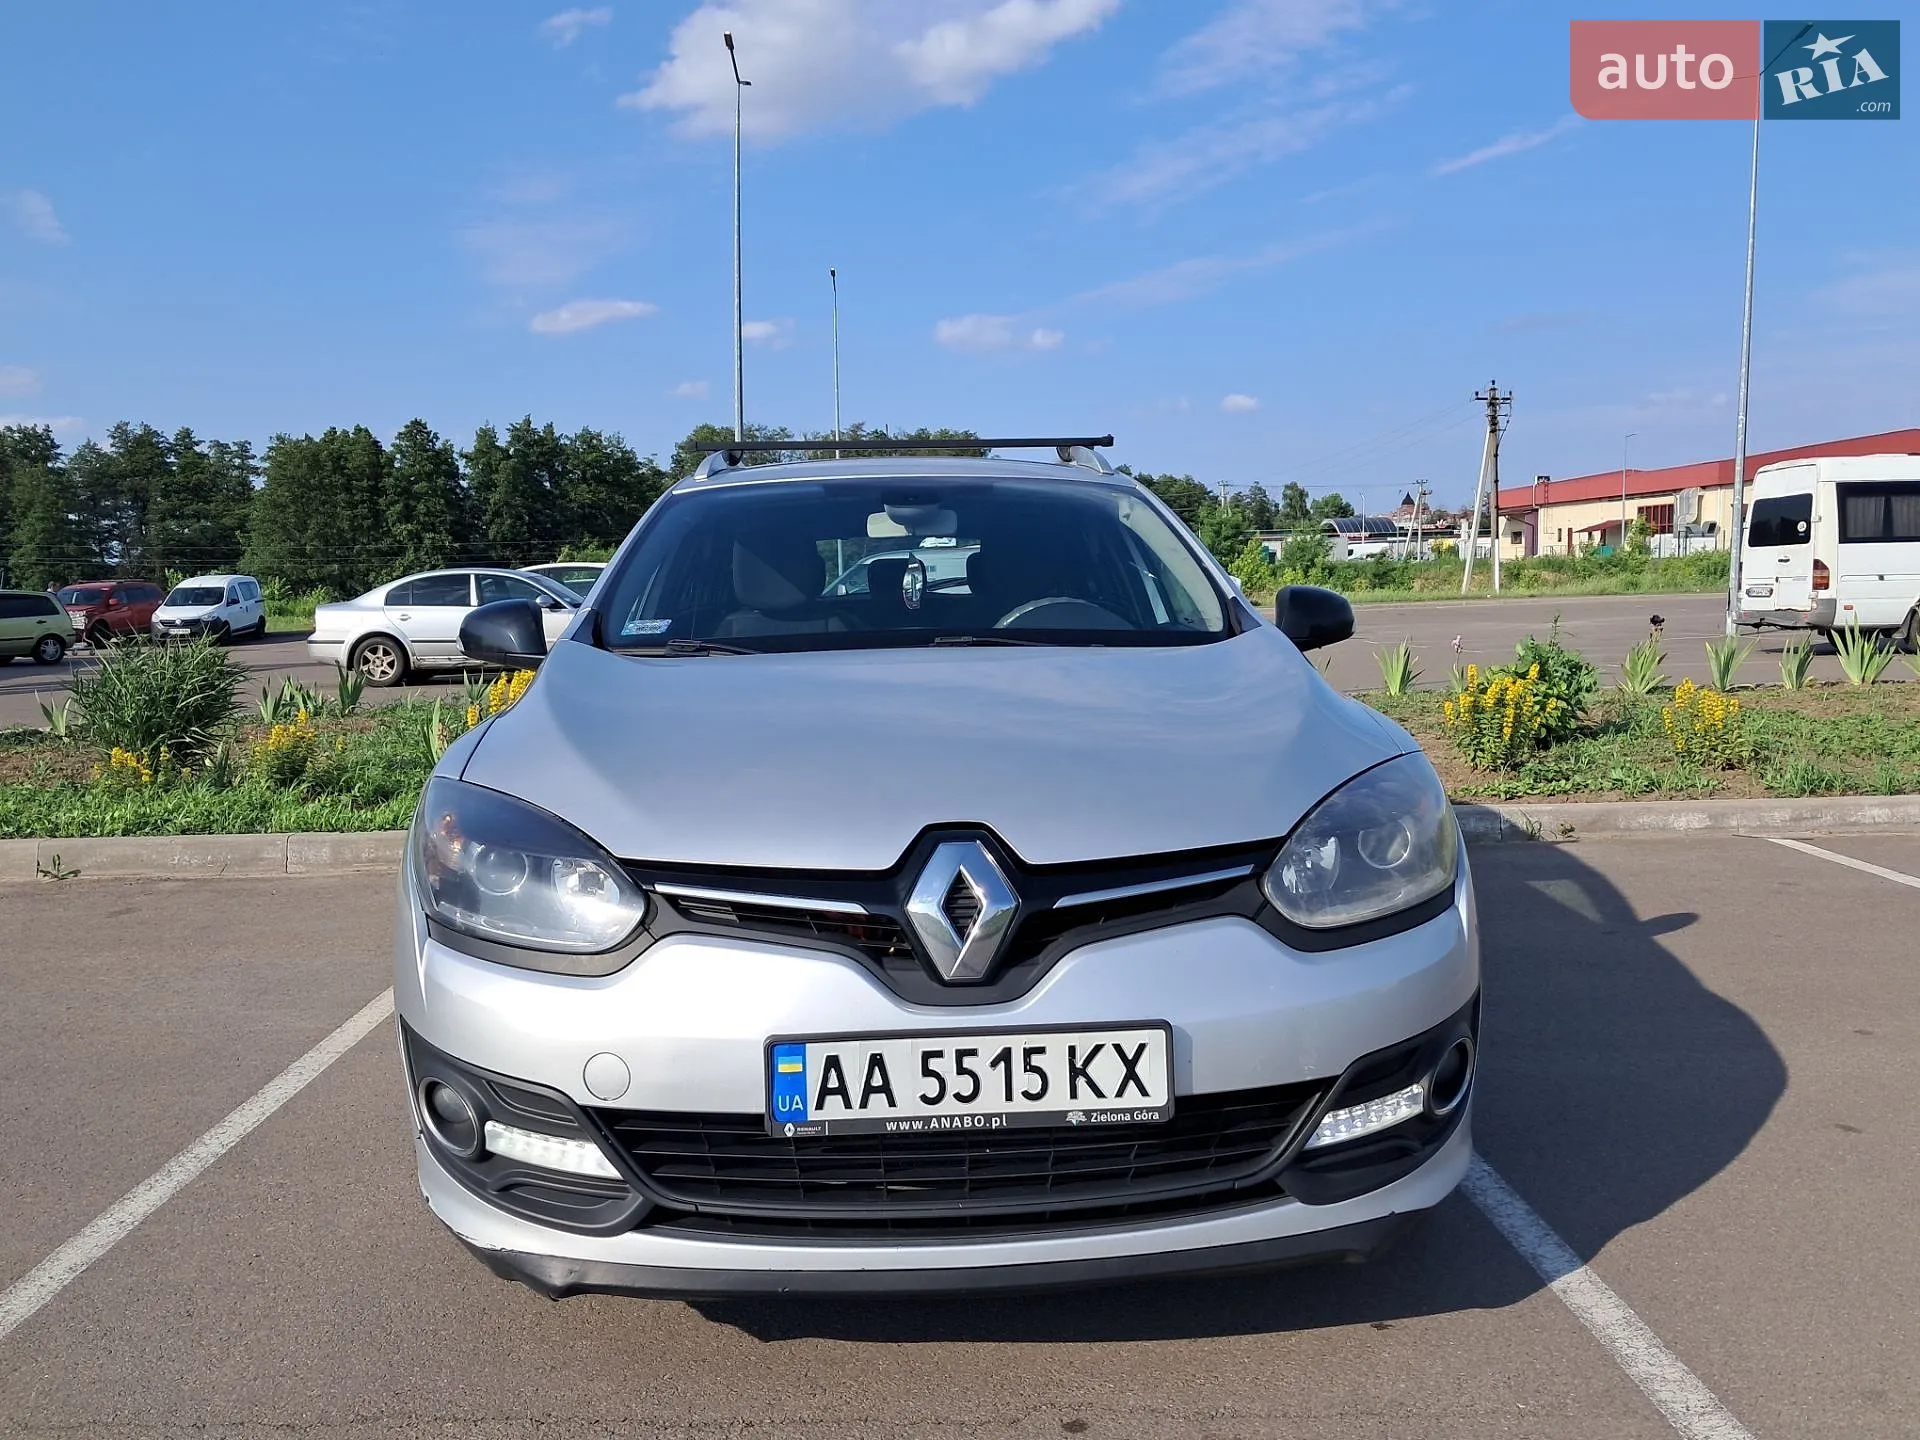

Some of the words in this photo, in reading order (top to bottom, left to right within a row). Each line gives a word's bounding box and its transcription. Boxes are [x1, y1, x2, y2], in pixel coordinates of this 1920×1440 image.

[814, 1053, 898, 1111] AA
[919, 1046, 1049, 1106] 5515
[1069, 1042, 1150, 1100] KX
[778, 1094, 804, 1112] UA
[886, 1114, 1008, 1131] www.ANABO.pl
[1090, 1111, 1131, 1123] Zielona
[1133, 1109, 1160, 1121] Góra
